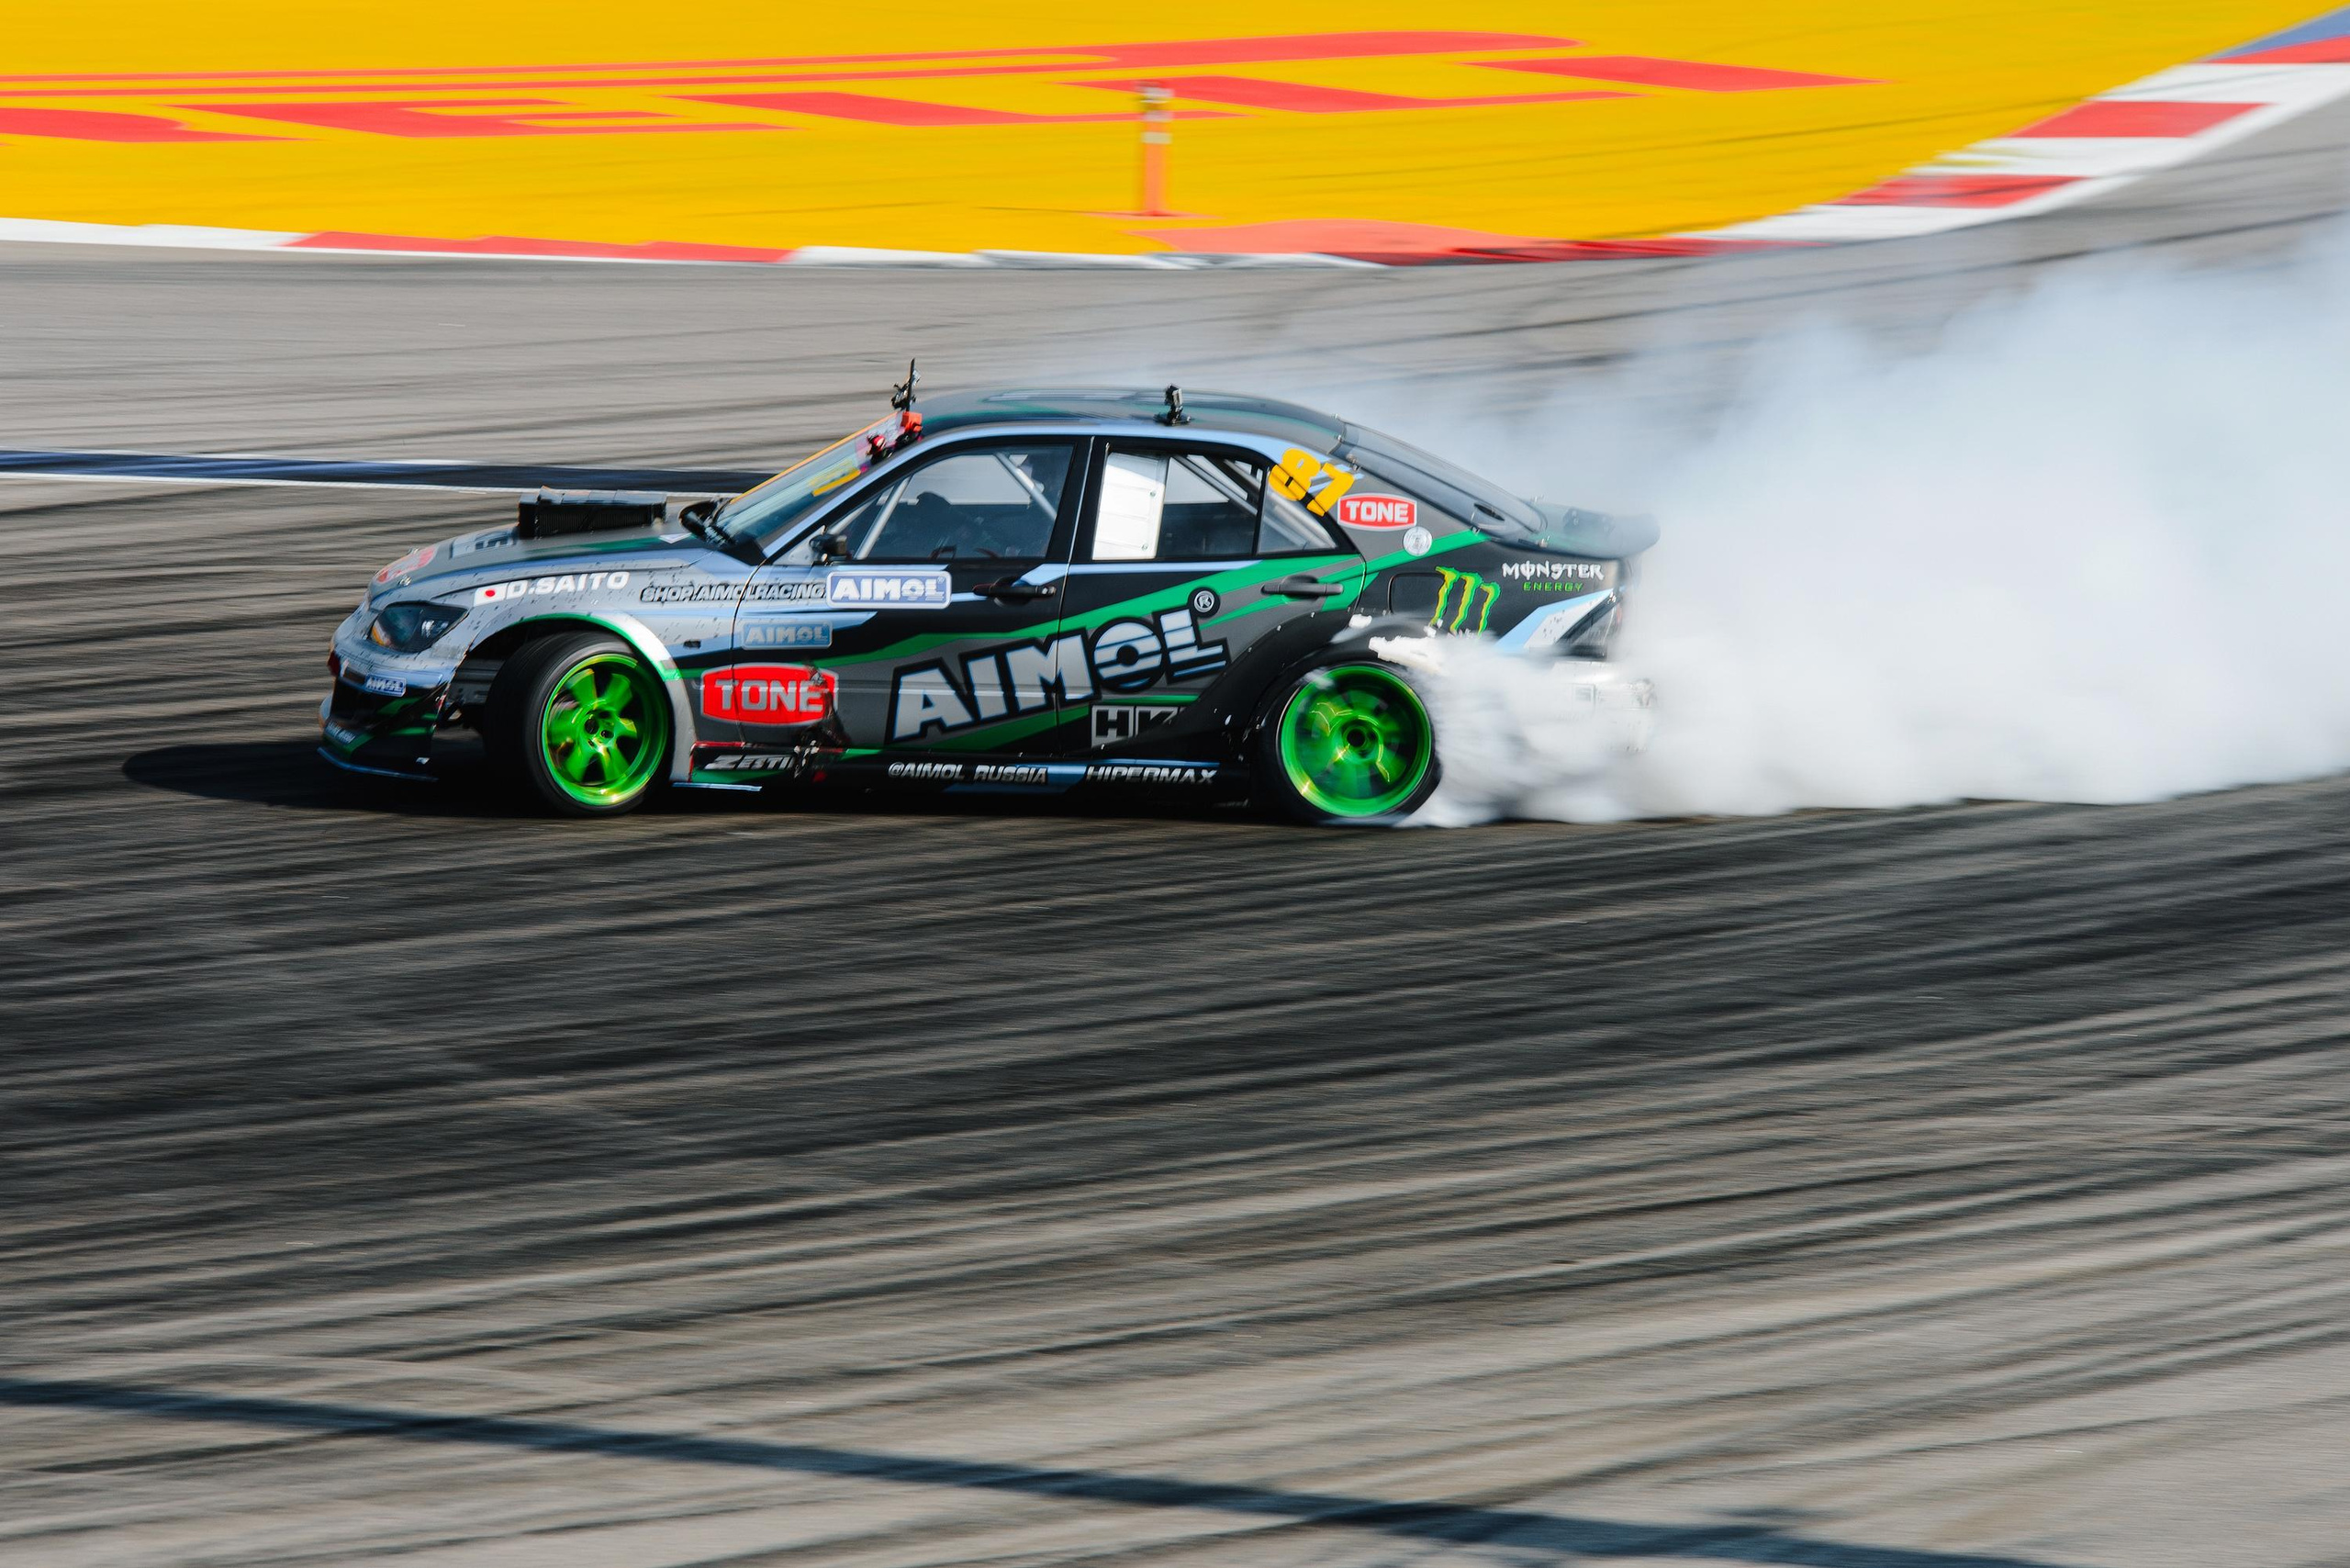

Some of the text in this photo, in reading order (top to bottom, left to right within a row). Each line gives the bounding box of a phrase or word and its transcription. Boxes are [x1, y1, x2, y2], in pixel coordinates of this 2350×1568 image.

[1268, 447, 1355, 518] 87
[1346, 500, 1409, 523] TONE
[1502, 560, 1605, 580] MONSTER
[506, 571, 631, 599] D.SAITO
[1523, 581, 1583, 592] ENERGY
[744, 626, 829, 644] AIMOL
[715, 678, 824, 712] TONE
[1086, 766, 1217, 784] HIPERMAX
